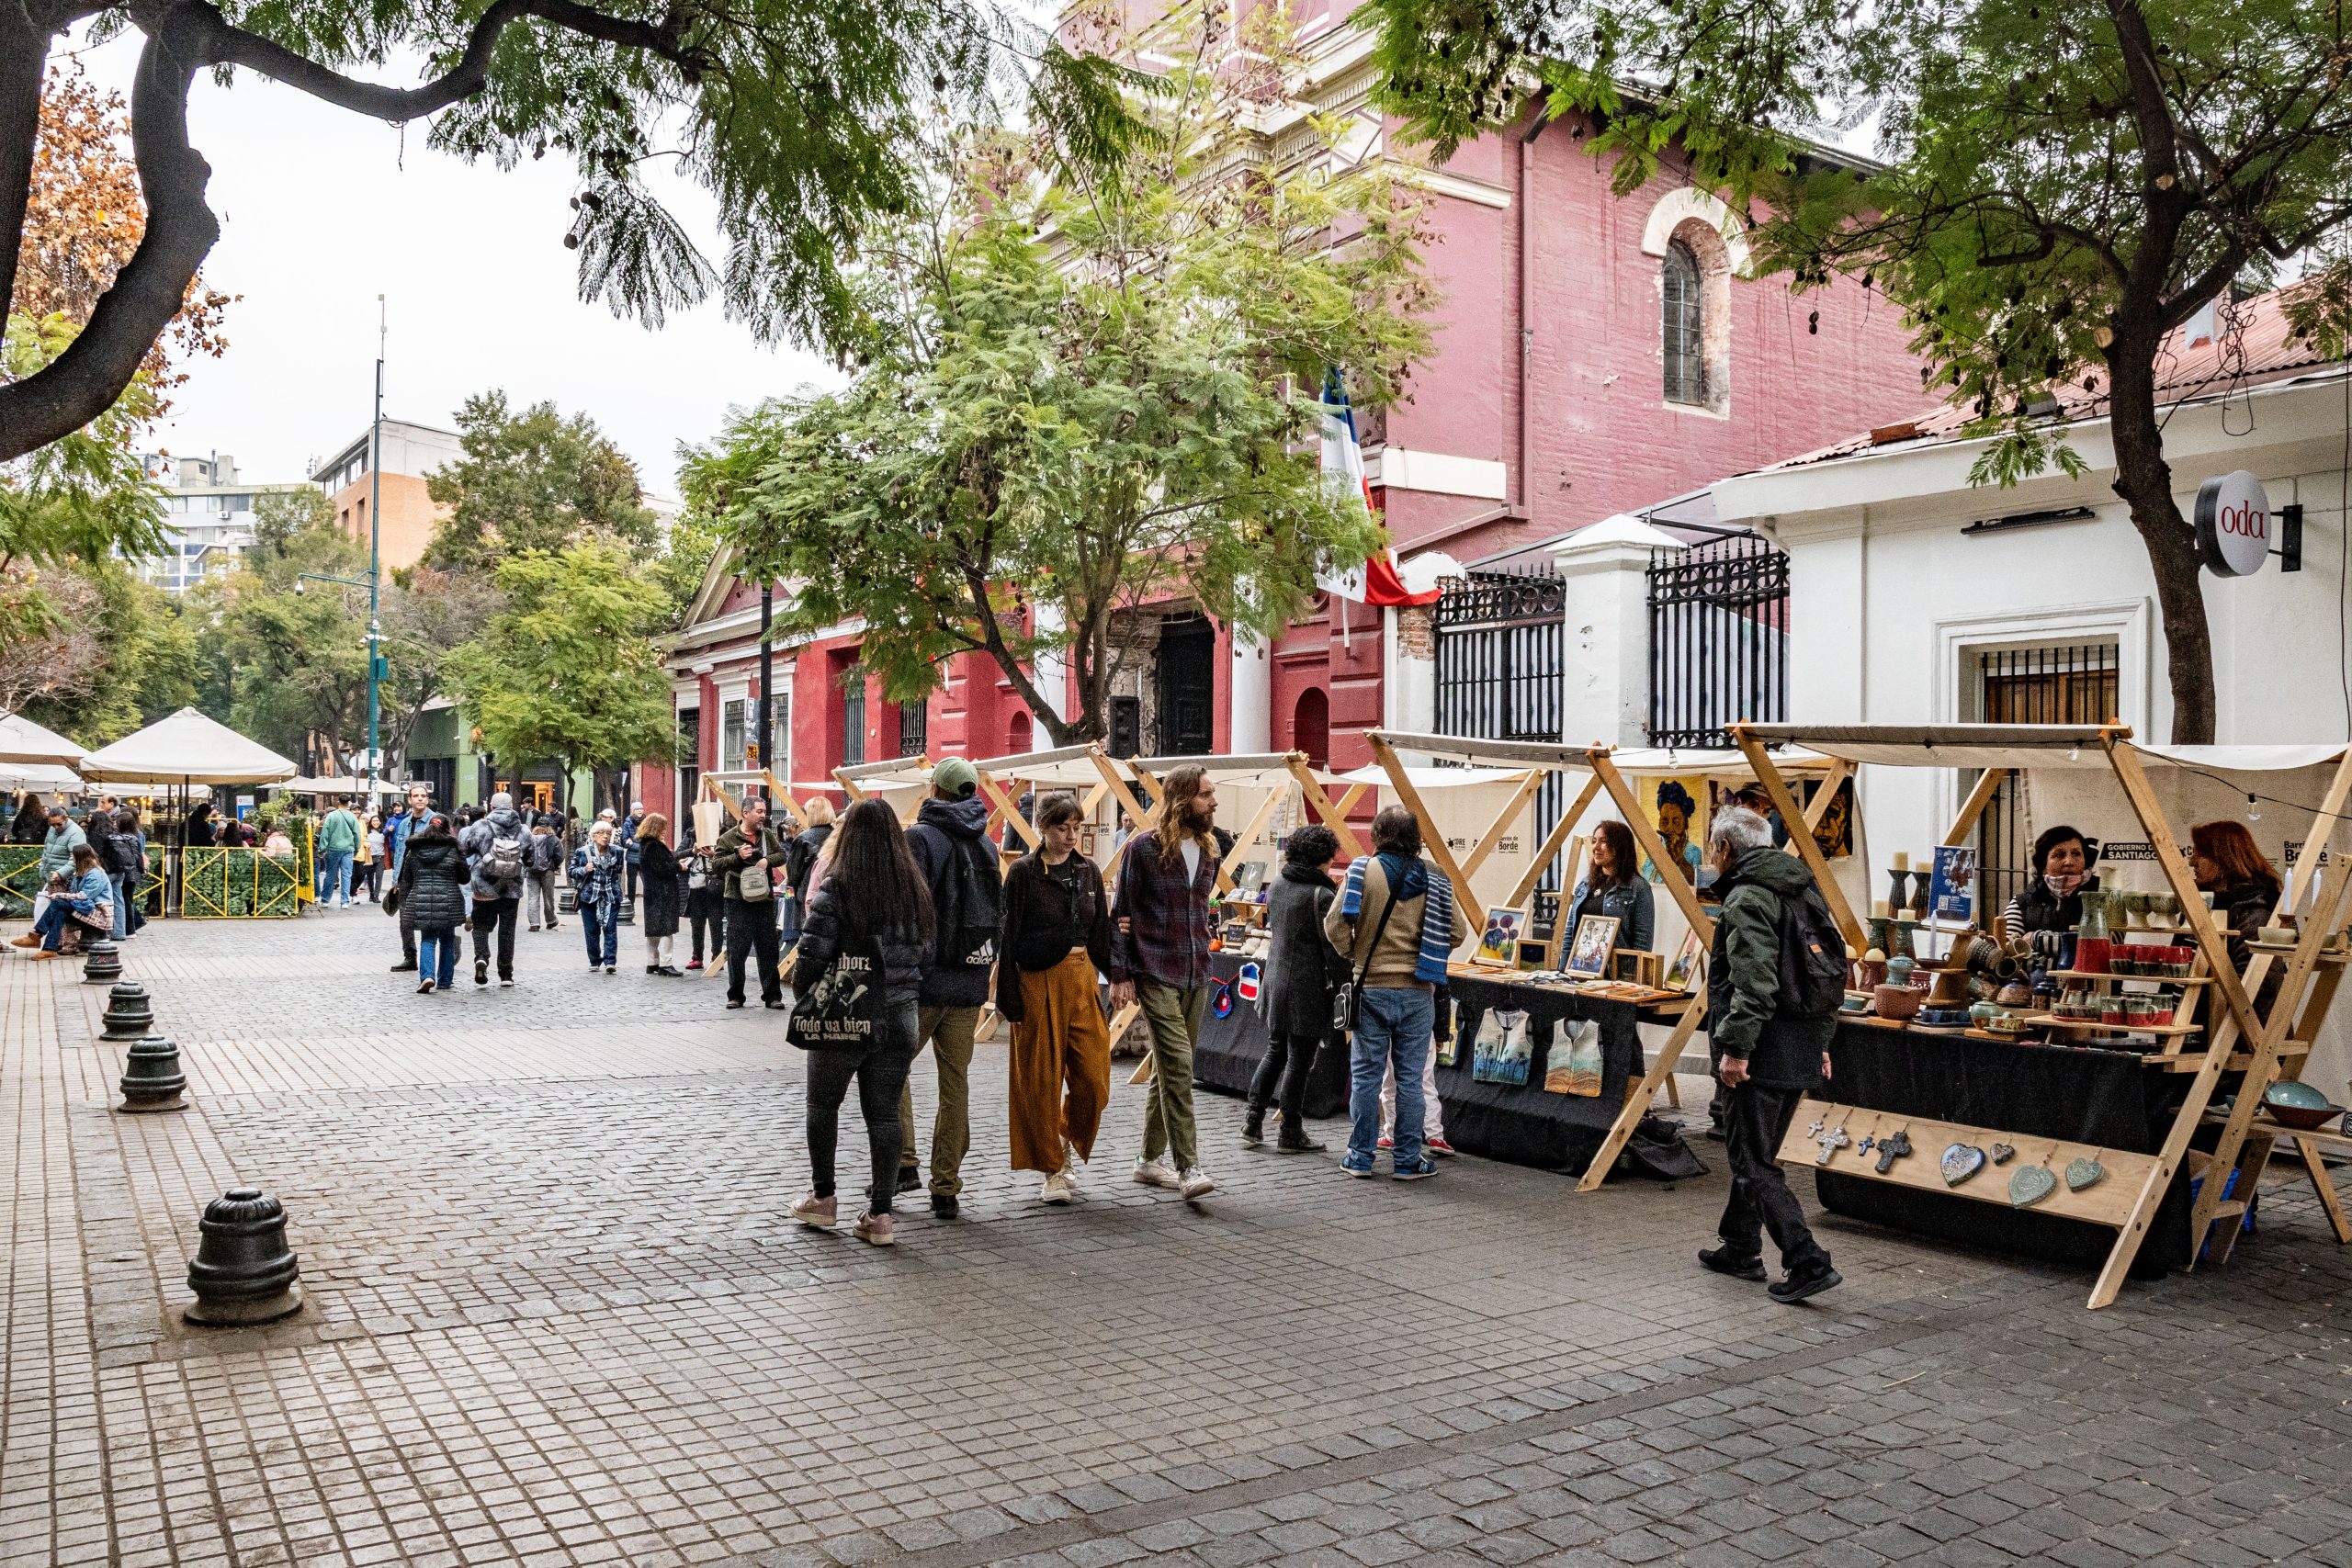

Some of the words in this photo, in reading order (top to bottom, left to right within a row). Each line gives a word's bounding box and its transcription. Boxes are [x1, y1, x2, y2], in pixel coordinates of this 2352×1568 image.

[2222, 500, 2265, 539] oda
[1498, 841, 1519, 850] Borde
[2285, 850, 2328, 863] Boe
[966, 955, 993, 964] adid
[793, 1015, 821, 1032] Todo
[825, 1020, 840, 1032] va
[843, 1016, 871, 1035] bien
